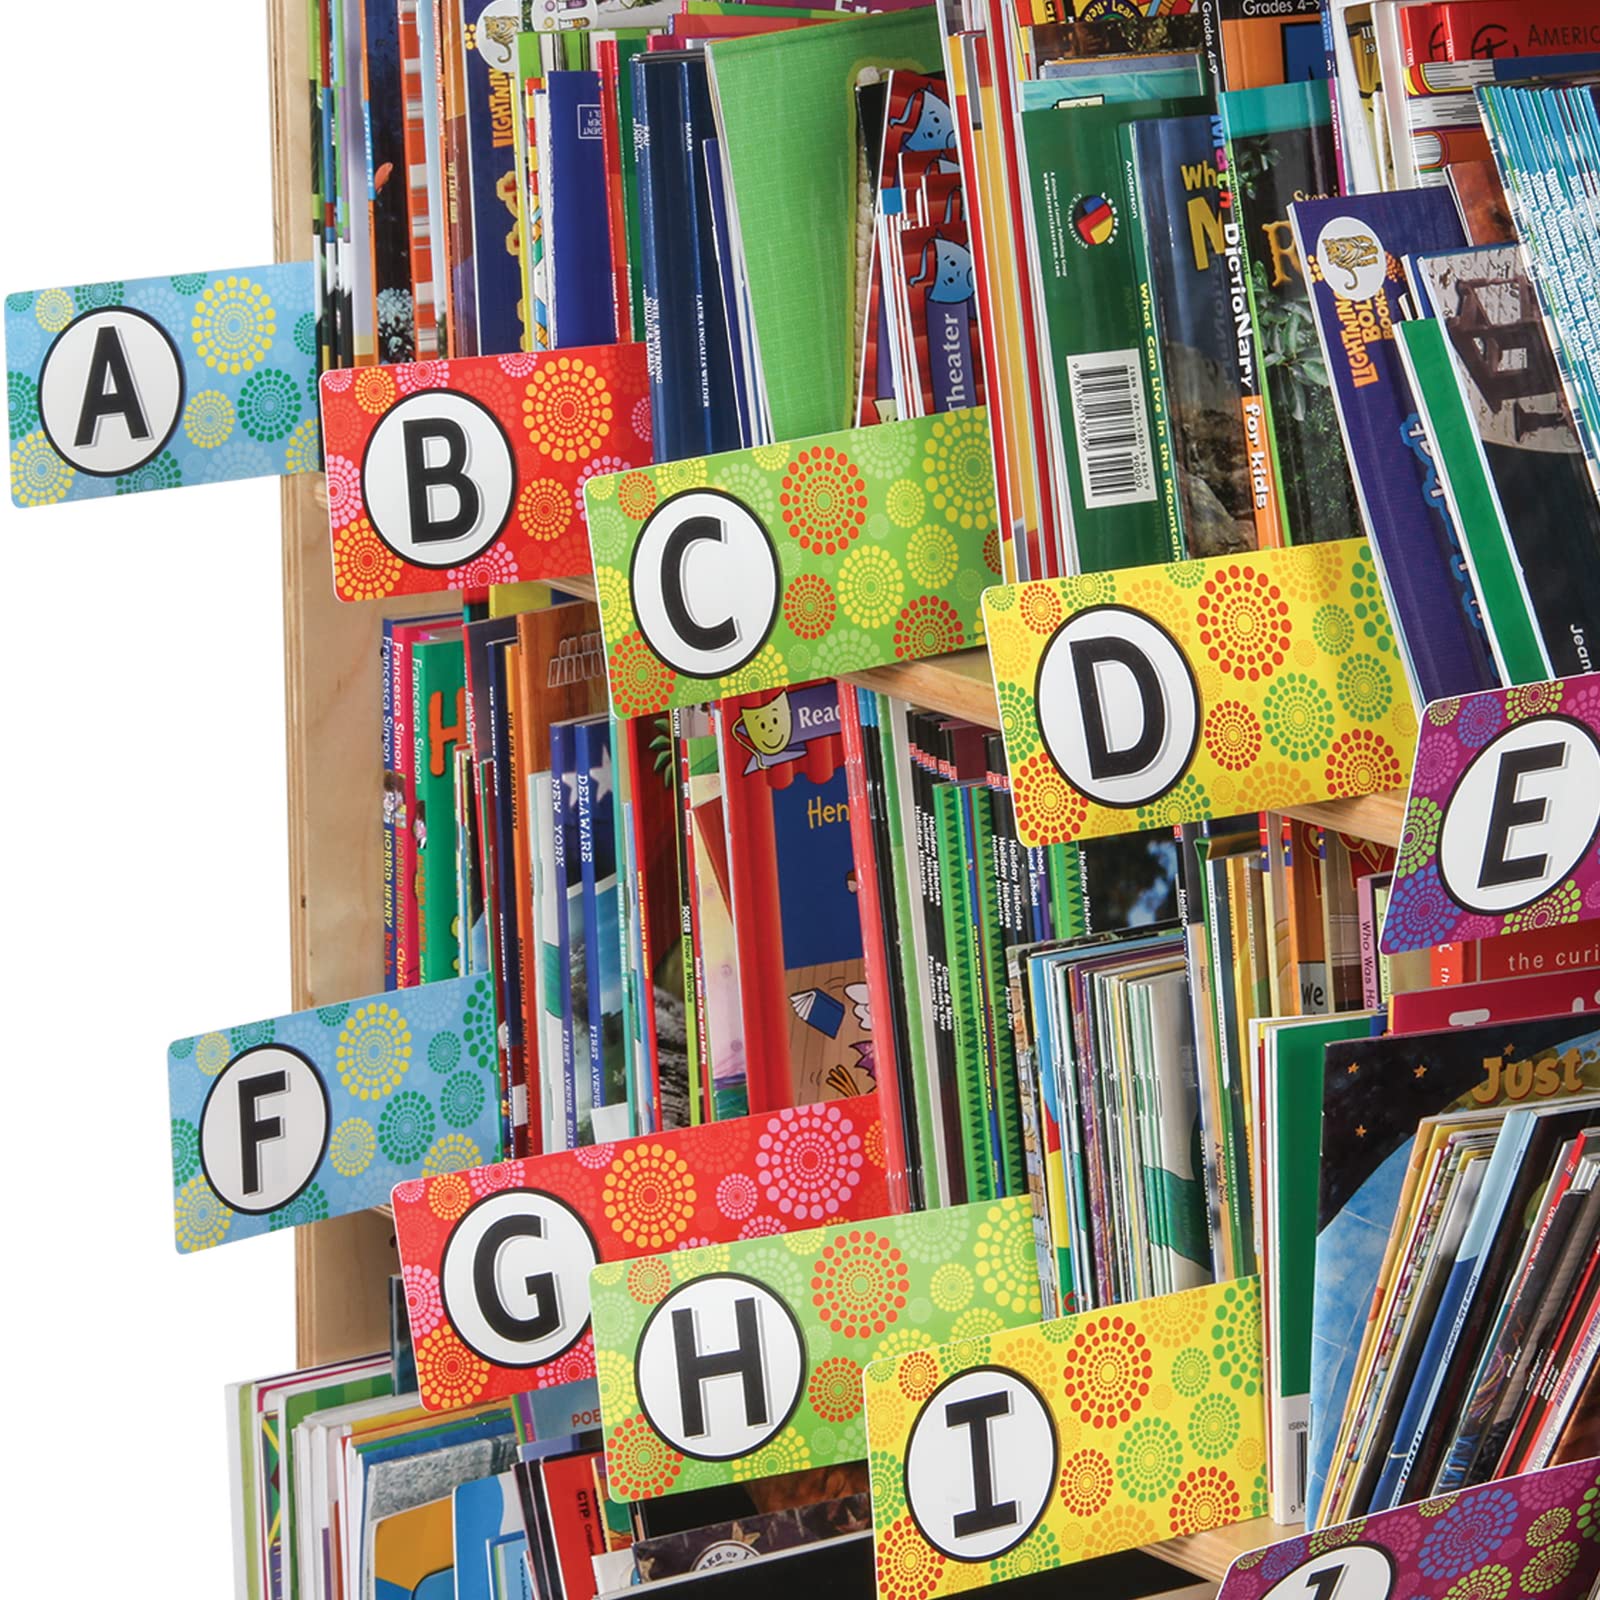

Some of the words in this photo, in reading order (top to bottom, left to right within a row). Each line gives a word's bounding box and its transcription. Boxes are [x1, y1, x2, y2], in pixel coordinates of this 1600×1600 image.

[1201, 0, 1215, 46] Grades
[1243, 0, 1293, 16] Grades
[684, 122, 692, 152] MARA
[1126, 159, 1138, 219] Anderson
[696, 293, 704, 325] LAURA
[1139, 282, 1153, 329] What
[698, 326, 706, 367] INGALLS
[1145, 334, 1158, 370] Can
[1569, 328, 1586, 360] Odds
[75, 327, 155, 446] A
[701, 368, 709, 407] WILDER
[1152, 376, 1165, 413] Live
[1156, 419, 1167, 438] in
[1132, 454, 1143, 488] 90000
[1160, 442, 1170, 471] the
[404, 419, 478, 543] B
[661, 517, 736, 650] C
[382, 636, 392, 710] Francesca
[393, 642, 403, 716] Francesca
[412, 657, 422, 731] Francesca
[1070, 637, 1164, 779] D
[383, 715, 392, 761] Simon
[393, 721, 404, 769] Simon
[414, 736, 423, 784] Simon
[550, 778, 562, 813] NEW
[576, 773, 593, 862] DELAWARE
[1478, 742, 1565, 888] E
[553, 824, 564, 867] YORK
[915, 804, 924, 847] Holiday
[997, 835, 1010, 880] Holiday
[1007, 838, 1019, 882] Holiday
[1078, 851, 1088, 893] Holiday
[384, 882, 392, 926] HENRY
[1000, 881, 1014, 929] Histories
[1011, 882, 1025, 931] Histories
[1361, 921, 1371, 950] Who
[1363, 956, 1373, 983] Was
[1509, 952, 1544, 972] the
[1301, 982, 1325, 1007] We
[562, 1029, 570, 1064] FIRST
[589, 1024, 598, 1060] FIRST
[564, 1071, 572, 1113] AVENUE
[1471, 1047, 1585, 1105] Just
[239, 1071, 285, 1194] F
[474, 1215, 559, 1342] G
[673, 1299, 767, 1437] H
[946, 1391, 1016, 1537] I
[575, 1490, 590, 1519] CTP
